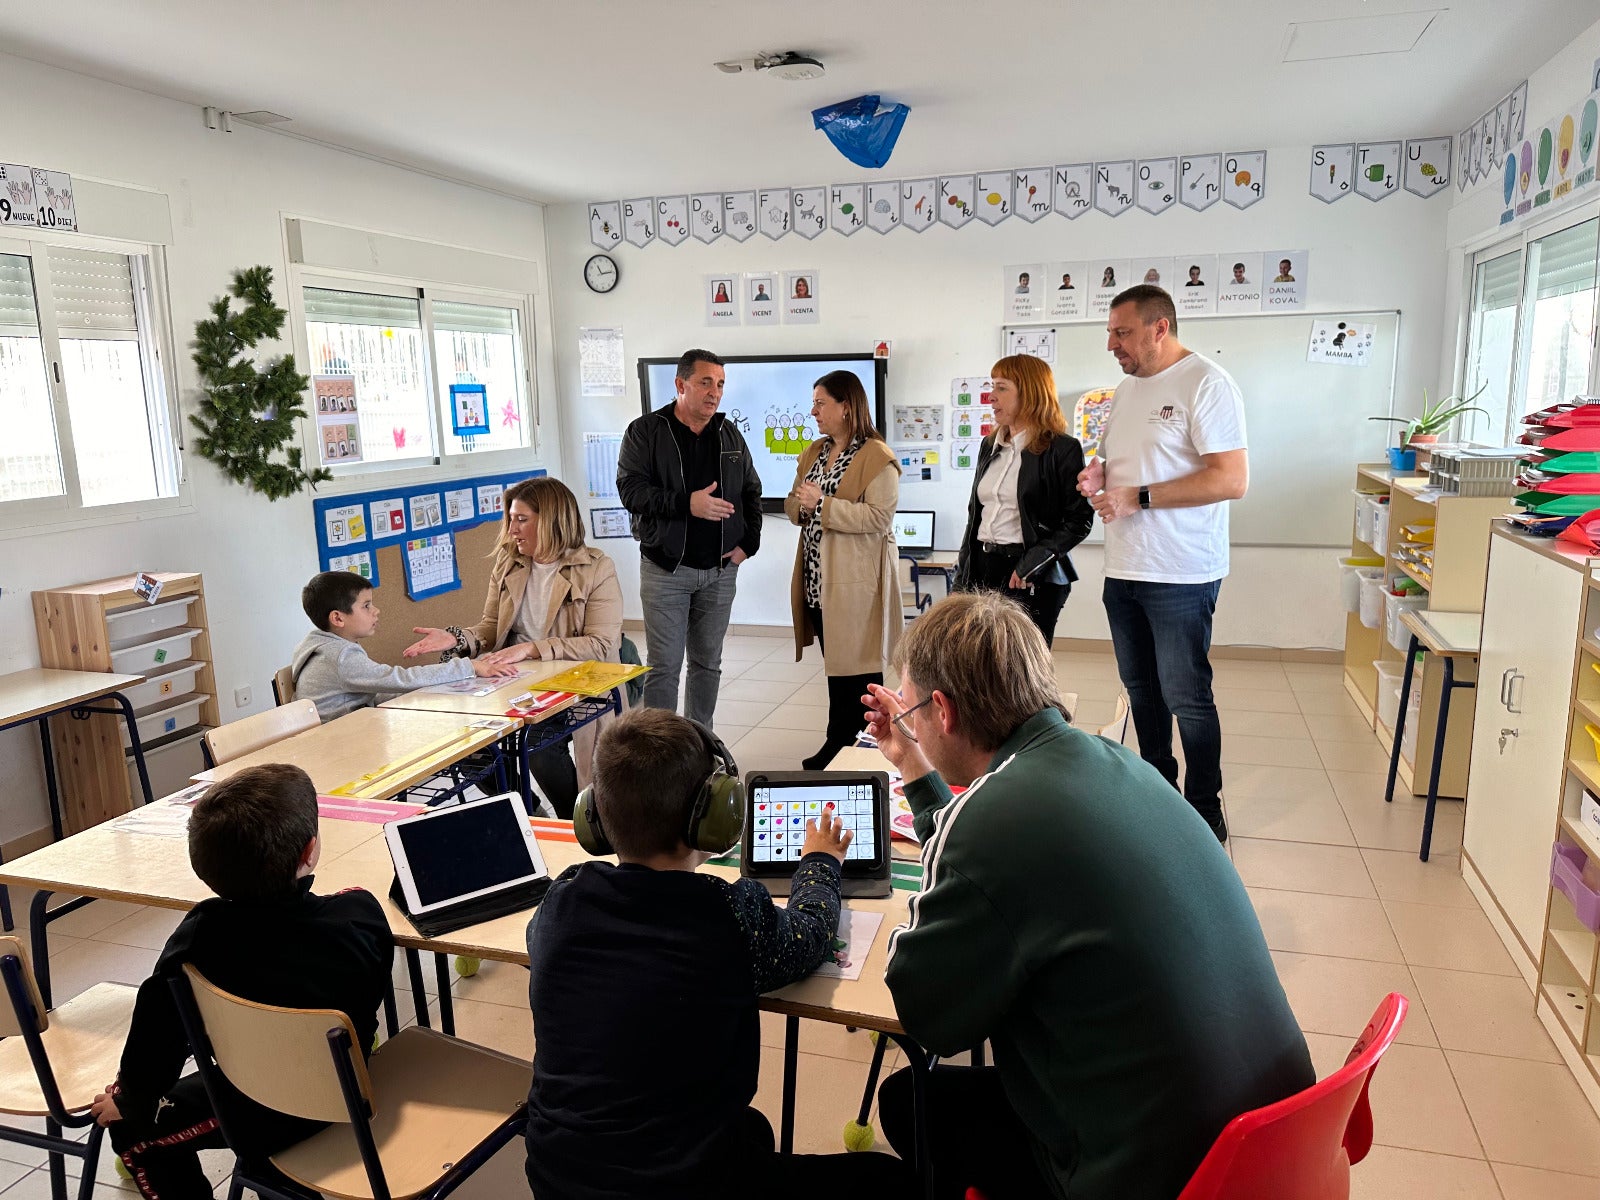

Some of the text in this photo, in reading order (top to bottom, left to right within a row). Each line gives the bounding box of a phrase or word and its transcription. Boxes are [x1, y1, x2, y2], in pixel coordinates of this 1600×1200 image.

[1314, 151, 1325, 165] S
[1360, 150, 1369, 163] T
[1409, 146, 1421, 160] U
[1182, 162, 1191, 175] P
[1226, 159, 1237, 173] Q
[1057, 171, 1067, 184] N
[1098, 167, 1108, 183] Ñ
[1140, 167, 1150, 180] O
[979, 177, 987, 191] L
[1017, 175, 1028, 188] M
[904, 187, 912, 199] J
[941, 181, 949, 196] K
[760, 195, 768, 207] F
[794, 193, 803, 206] G
[832, 190, 841, 202] H
[868, 188, 872, 203] I
[0, 198, 35, 221] 9 NUEVE
[658, 202, 667, 214] C
[693, 199, 701, 211] D
[726, 197, 734, 209] E
[39, 206, 55, 226] 10
[591, 209, 600, 220] A
[624, 204, 633, 216] B
[1219, 293, 1260, 301] ANTONIO
[1325, 350, 1353, 358] MAMBA
